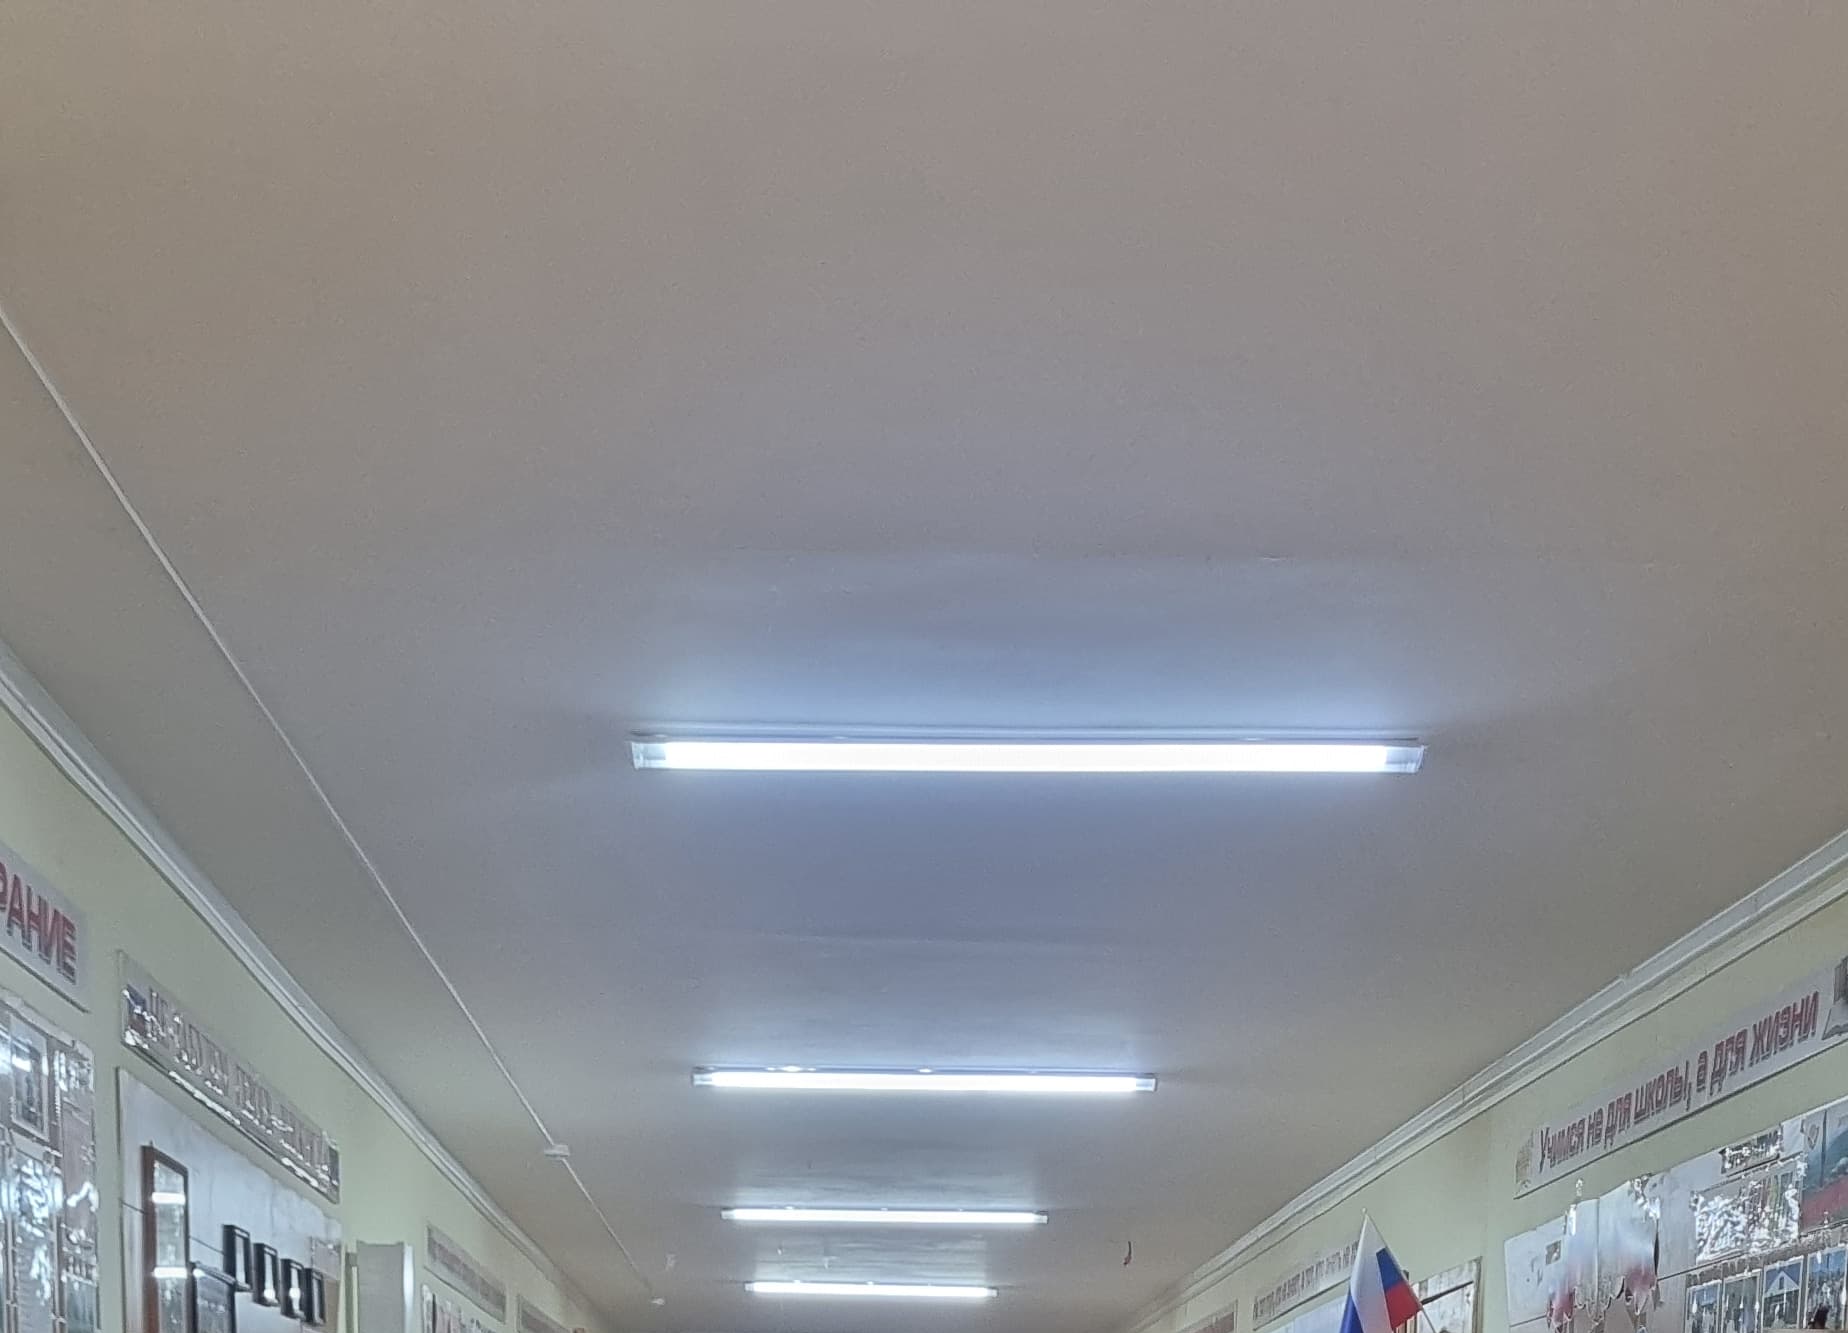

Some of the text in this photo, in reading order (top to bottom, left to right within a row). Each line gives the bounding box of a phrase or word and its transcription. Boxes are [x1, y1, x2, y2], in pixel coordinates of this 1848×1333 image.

[1587, 1108, 1603, 1149] не
[1604, 1092, 1632, 1149] для
[1710, 1028, 1748, 1096] для
